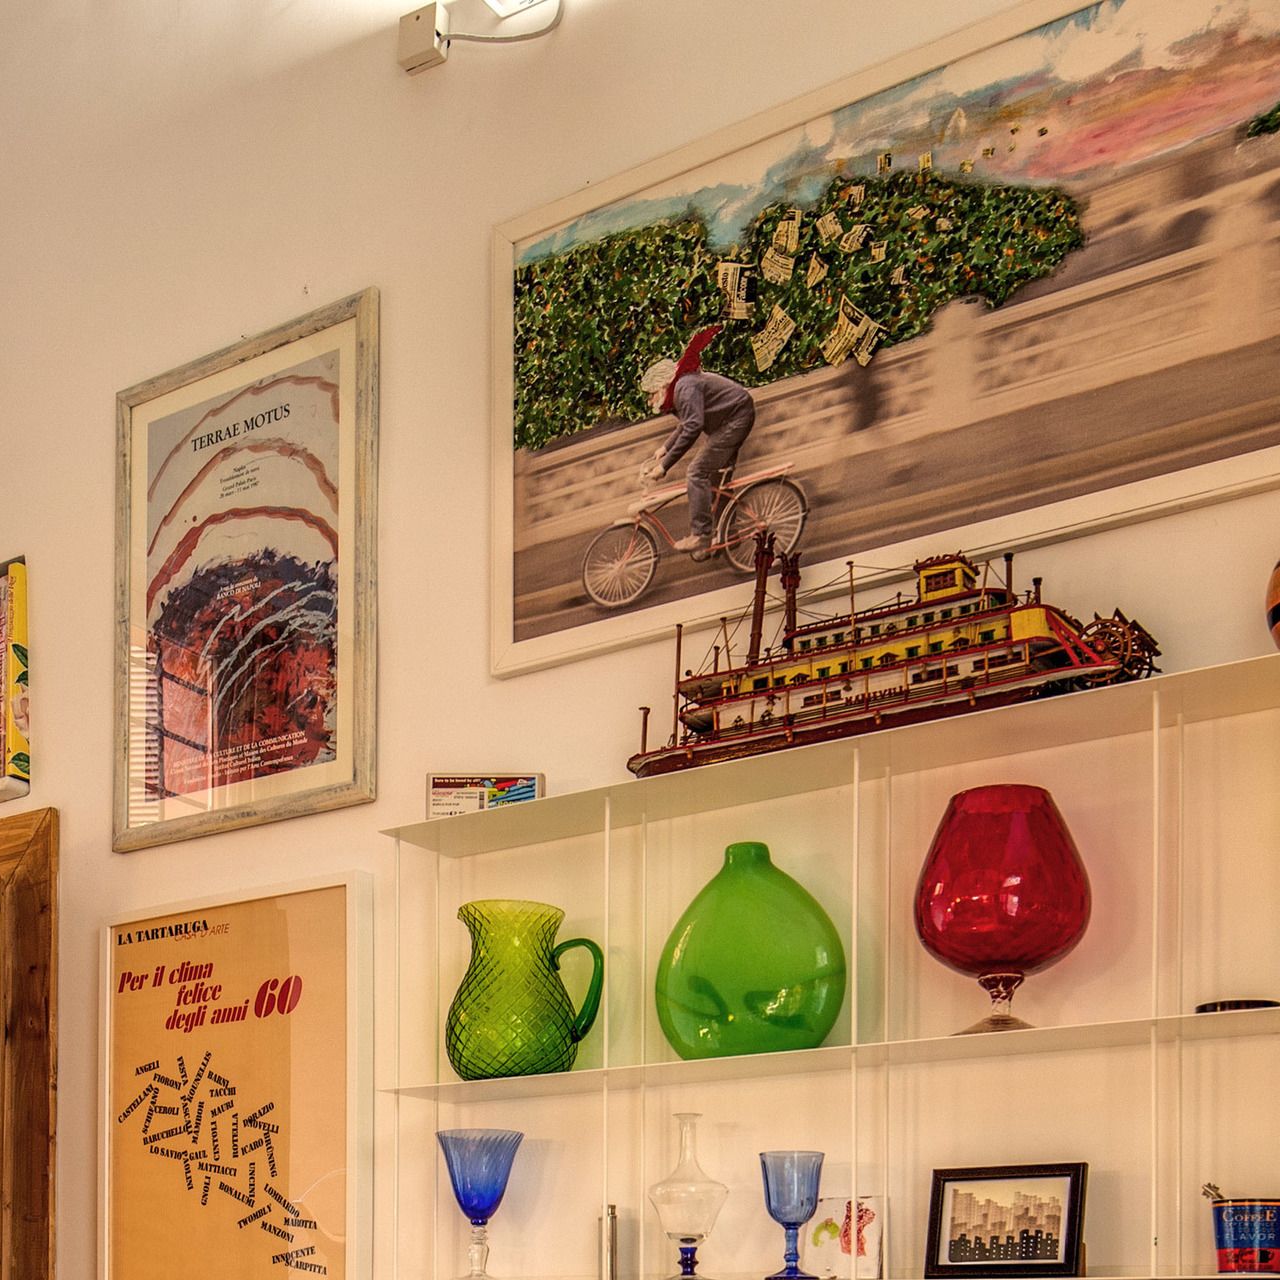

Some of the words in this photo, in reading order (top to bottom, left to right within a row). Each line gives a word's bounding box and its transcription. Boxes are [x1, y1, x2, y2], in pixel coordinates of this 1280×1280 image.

[191, 423, 240, 452] TERRAE
[243, 403, 291, 433] MOTUS
[117, 934, 133, 945] LA
[136, 920, 209, 942] TARTARUGA
[117, 971, 149, 994] Per
[152, 966, 166, 988] il
[168, 960, 215, 986] clima
[165, 1005, 208, 1034] degli
[210, 1000, 250, 1024] anni
[253, 975, 303, 1019] 60
[176, 983, 223, 1007] felice
[135, 1060, 160, 1076] ANGELI
[187, 1051, 212, 1103] KOUNELLIS
[207, 1071, 230, 1088] BARNI
[153, 1073, 182, 1091] FIORONI
[209, 1087, 236, 1098] TACCHI
[117, 1083, 156, 1124] CASTELLANI
[154, 1106, 179, 1116] CEROLI
[210, 1100, 234, 1117] MAURI
[191, 1101, 205, 1144] MAMBOR
[143, 1125, 188, 1145] BARUCHELLO
[210, 1121, 220, 1161] CINTOLI
[241, 1138, 264, 1156] ICARO
[149, 1145, 159, 1154] LO
[160, 1148, 182, 1160] SAVIO
[182, 1150, 194, 1191] PAOLINI
[197, 1162, 237, 1177] MATTIACCI
[248, 1162, 256, 1198] UNCINI
[201, 1176, 211, 1206] GNOLI
[219, 1181, 256, 1208] BONALUMI
[264, 1183, 300, 1218] LOMBARDO
[237, 1203, 273, 1229] TWOMBLY
[284, 1217, 318, 1230] MAROTTA
[260, 1221, 295, 1243] MANZONI
[272, 1246, 316, 1265] INNOCENTE
[284, 1259, 328, 1275] SCARPITTA
